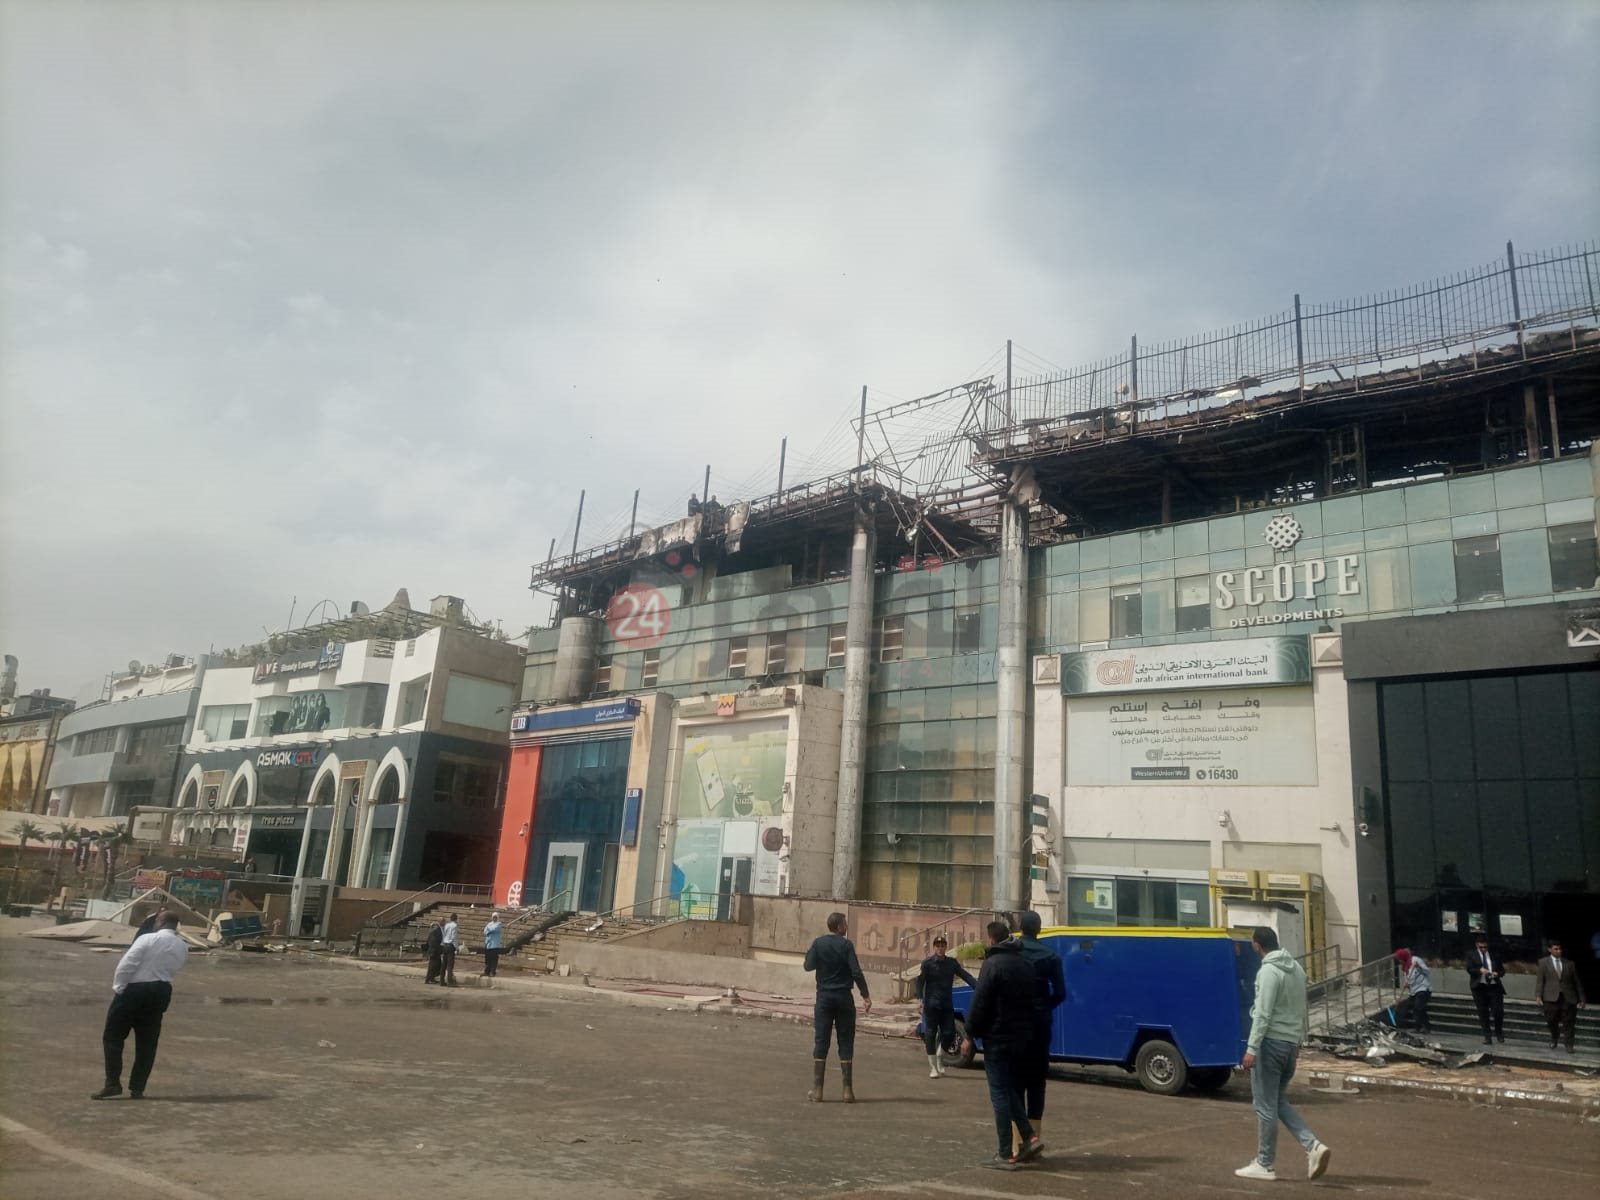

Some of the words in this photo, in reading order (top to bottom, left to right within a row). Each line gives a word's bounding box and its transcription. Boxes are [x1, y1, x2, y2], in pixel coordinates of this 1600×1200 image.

[1215, 555, 1360, 610] SCOPE
[1230, 607, 1344, 628] DEVELOPMENTS
[1135, 674, 1154, 683] arab
[1155, 673, 1184, 682] african
[1186, 668, 1243, 680] international
[1245, 667, 1268, 677] bank
[256, 751, 292, 767] ASMAK
[1207, 769, 1239, 780] 16430
